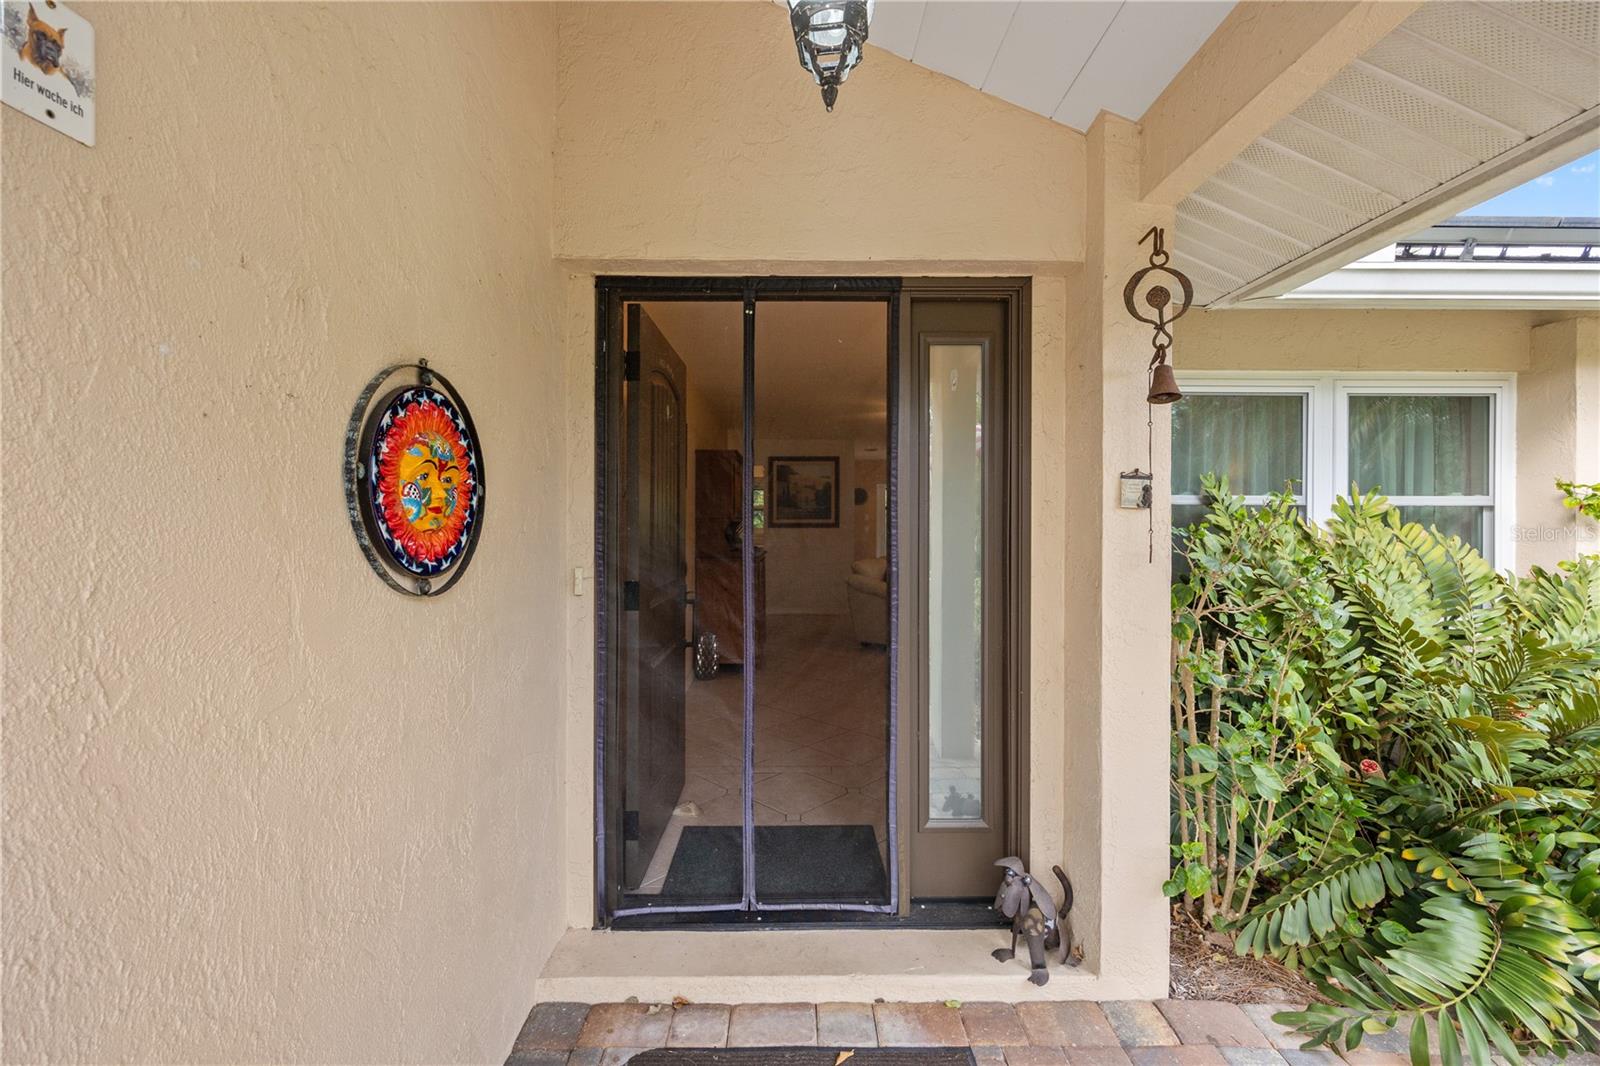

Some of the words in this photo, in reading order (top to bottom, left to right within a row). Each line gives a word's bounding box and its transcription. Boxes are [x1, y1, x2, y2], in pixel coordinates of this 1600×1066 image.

[13, 67, 35, 89] Hier
[36, 83, 69, 109] wache
[70, 100, 84, 118] ich
